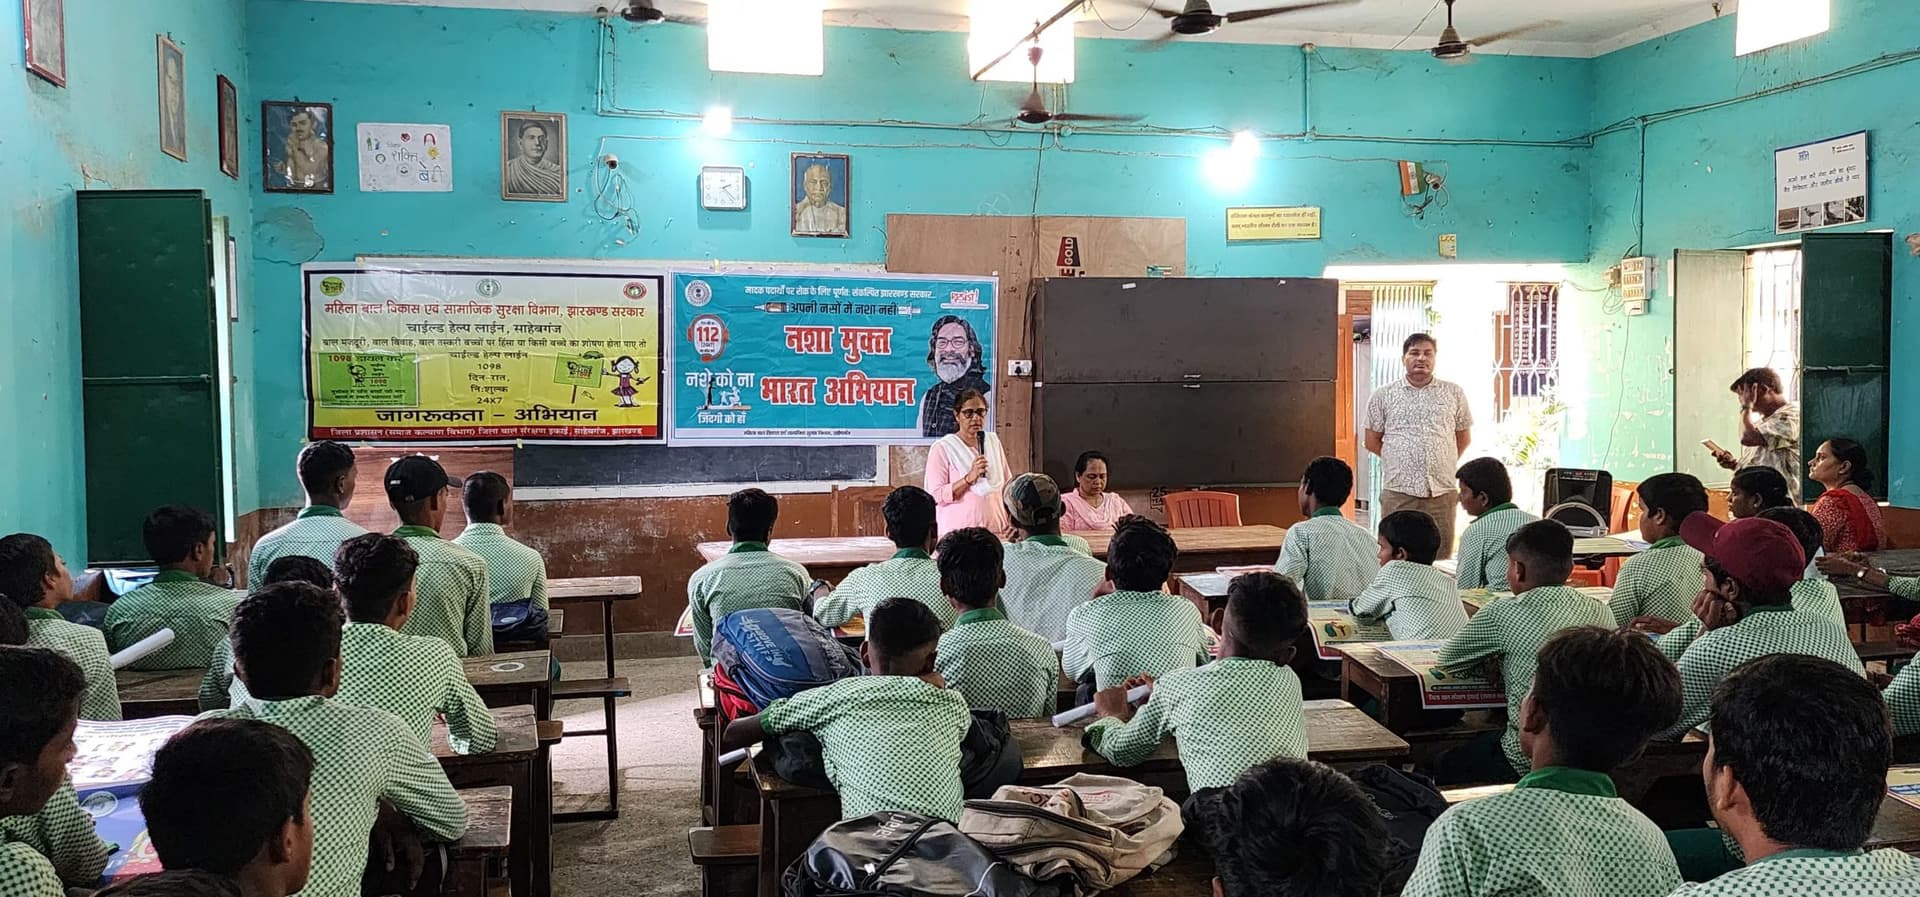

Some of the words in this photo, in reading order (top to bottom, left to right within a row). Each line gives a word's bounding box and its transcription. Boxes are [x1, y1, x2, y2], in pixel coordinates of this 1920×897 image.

[1065, 238, 1073, 265] GOLD
[745, 286, 764, 294] मादक
[786, 287, 795, 295] पर
[796, 285, 809, 295] रोक
[810, 286, 817, 295] के
[818, 286, 831, 296] लिए
[325, 299, 357, 315] महिला
[361, 303, 383, 314] बाल
[387, 300, 420, 314] विकास
[425, 301, 439, 315] एवं
[444, 300, 492, 315] सामाजिक
[496, 303, 524, 319] सुरक्षा
[528, 301, 563, 318] विभाग,
[567, 305, 609, 318] झारखण्ड
[611, 306, 645, 318] सरकार
[790, 301, 816, 313] अपनी
[820, 301, 840, 314] नसों
[844, 301, 853, 314] में
[855, 303, 875, 315] नशा
[406, 320, 445, 333] चाईल्ड
[448, 319, 471, 333] हेल्प
[513, 321, 562, 334] साहेबगंज
[696, 326, 719, 342] 112
[322, 338, 338, 346] बाल
[372, 338, 388, 346] बाल
[419, 338, 435, 346] बाल
[437, 337, 461, 346] तस्करी
[499, 337, 514, 347] हिंसा
[528, 337, 547, 347] किसी
[569, 339, 580, 347] का
[582, 337, 604, 347] शोषण
[607, 338, 621, 347] होता
[639, 338, 647, 348] तो
[784, 326, 834, 353] नशा
[839, 326, 892, 364] मुक्त
[483, 350, 501, 360] हेल्प
[504, 350, 528, 359] लाईन
[685, 368, 713, 387] नशे
[715, 368, 734, 387] को
[736, 372, 755, 387] ना
[761, 377, 816, 404] भारत
[824, 370, 916, 405] अभियान
[376, 409, 484, 422] जागरूकता
[514, 404, 598, 421] अभियान
[724, 412, 736, 424] को
[330, 427, 351, 436] जिला
[414, 428, 444, 436] कल्याण
[478, 426, 498, 435] जिला
[501, 427, 518, 435] बाल
[520, 426, 546, 435] संरक्षण
